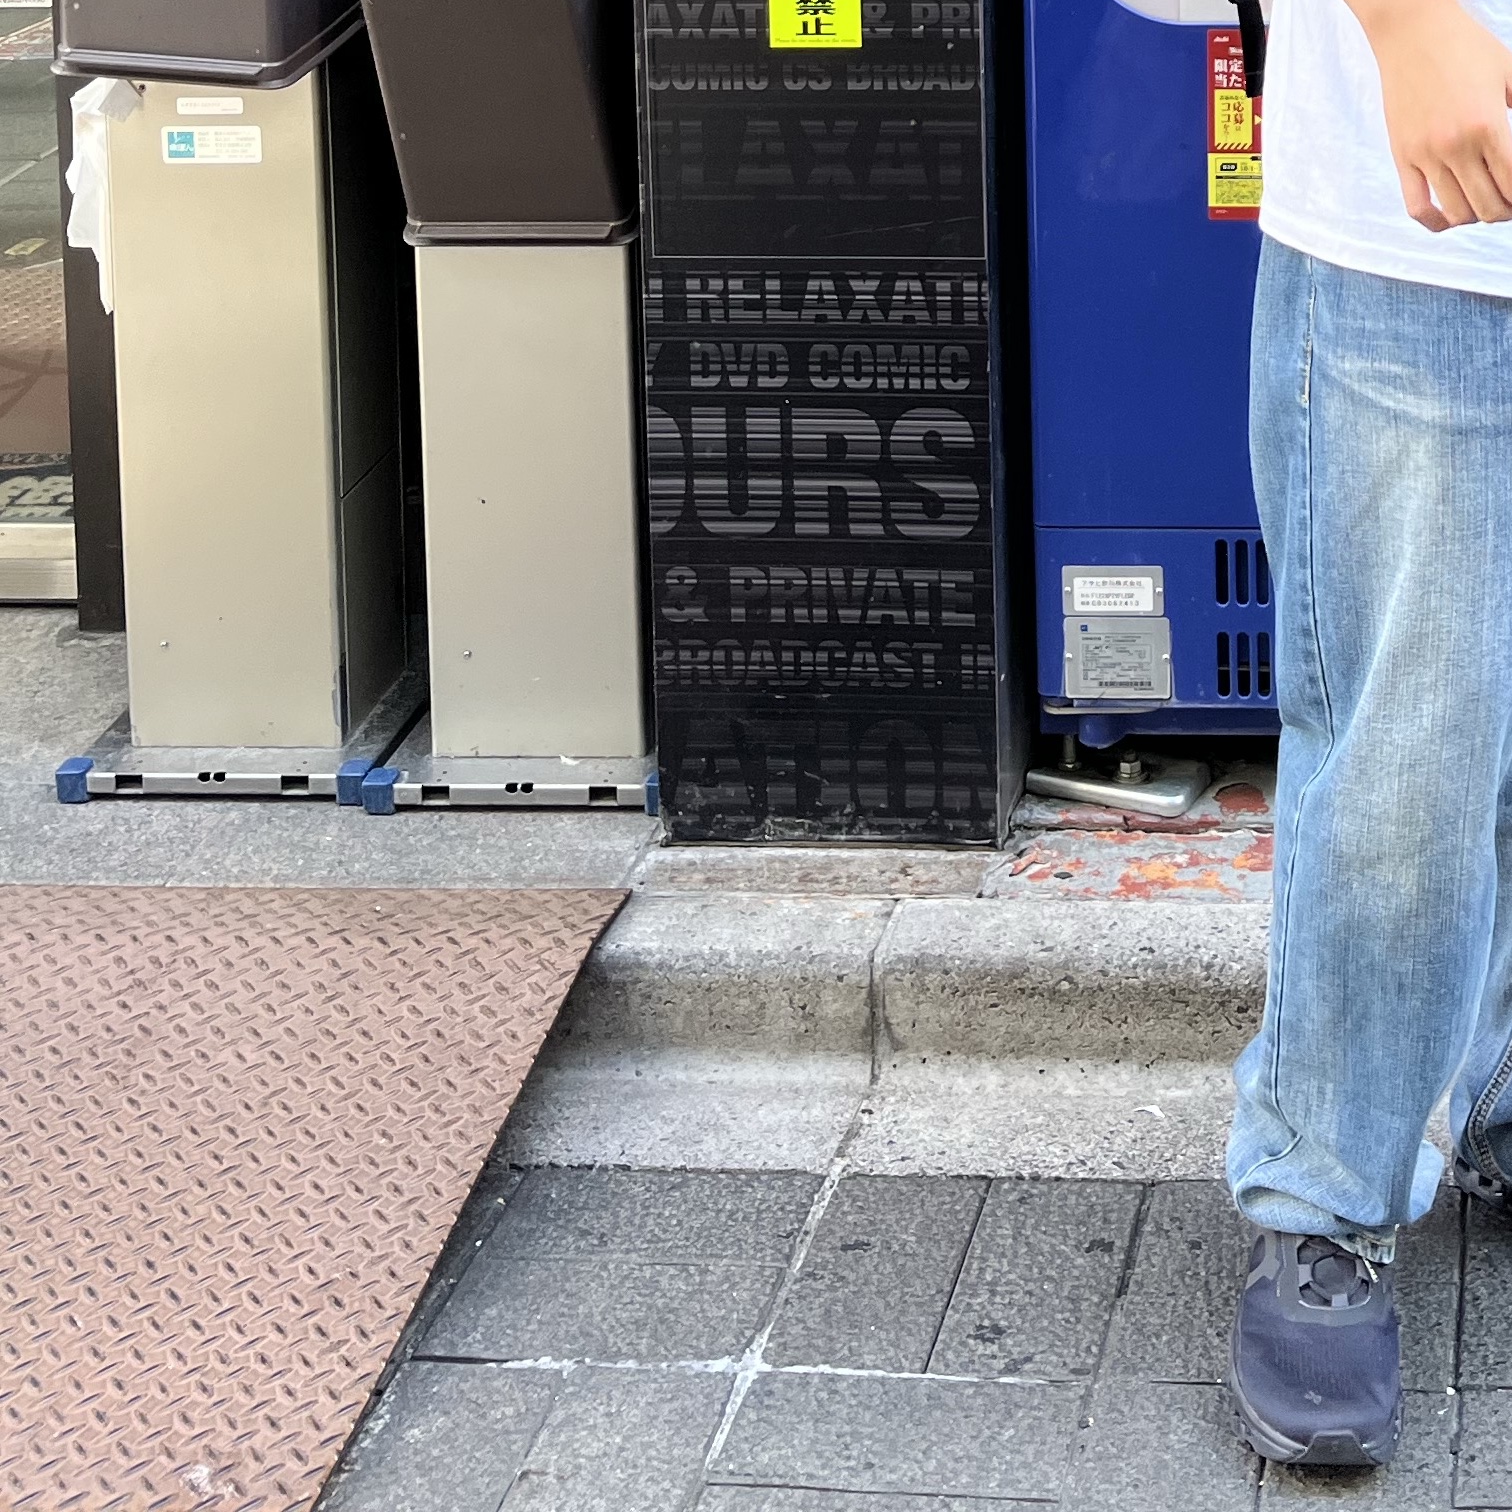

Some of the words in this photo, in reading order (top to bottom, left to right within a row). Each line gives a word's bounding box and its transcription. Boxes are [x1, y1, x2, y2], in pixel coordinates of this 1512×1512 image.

[1213, 58, 1243, 74] 限定
[690, 343, 790, 388] DVD
[808, 344, 971, 390] COMIC
[729, 566, 976, 627] PRIVATE
